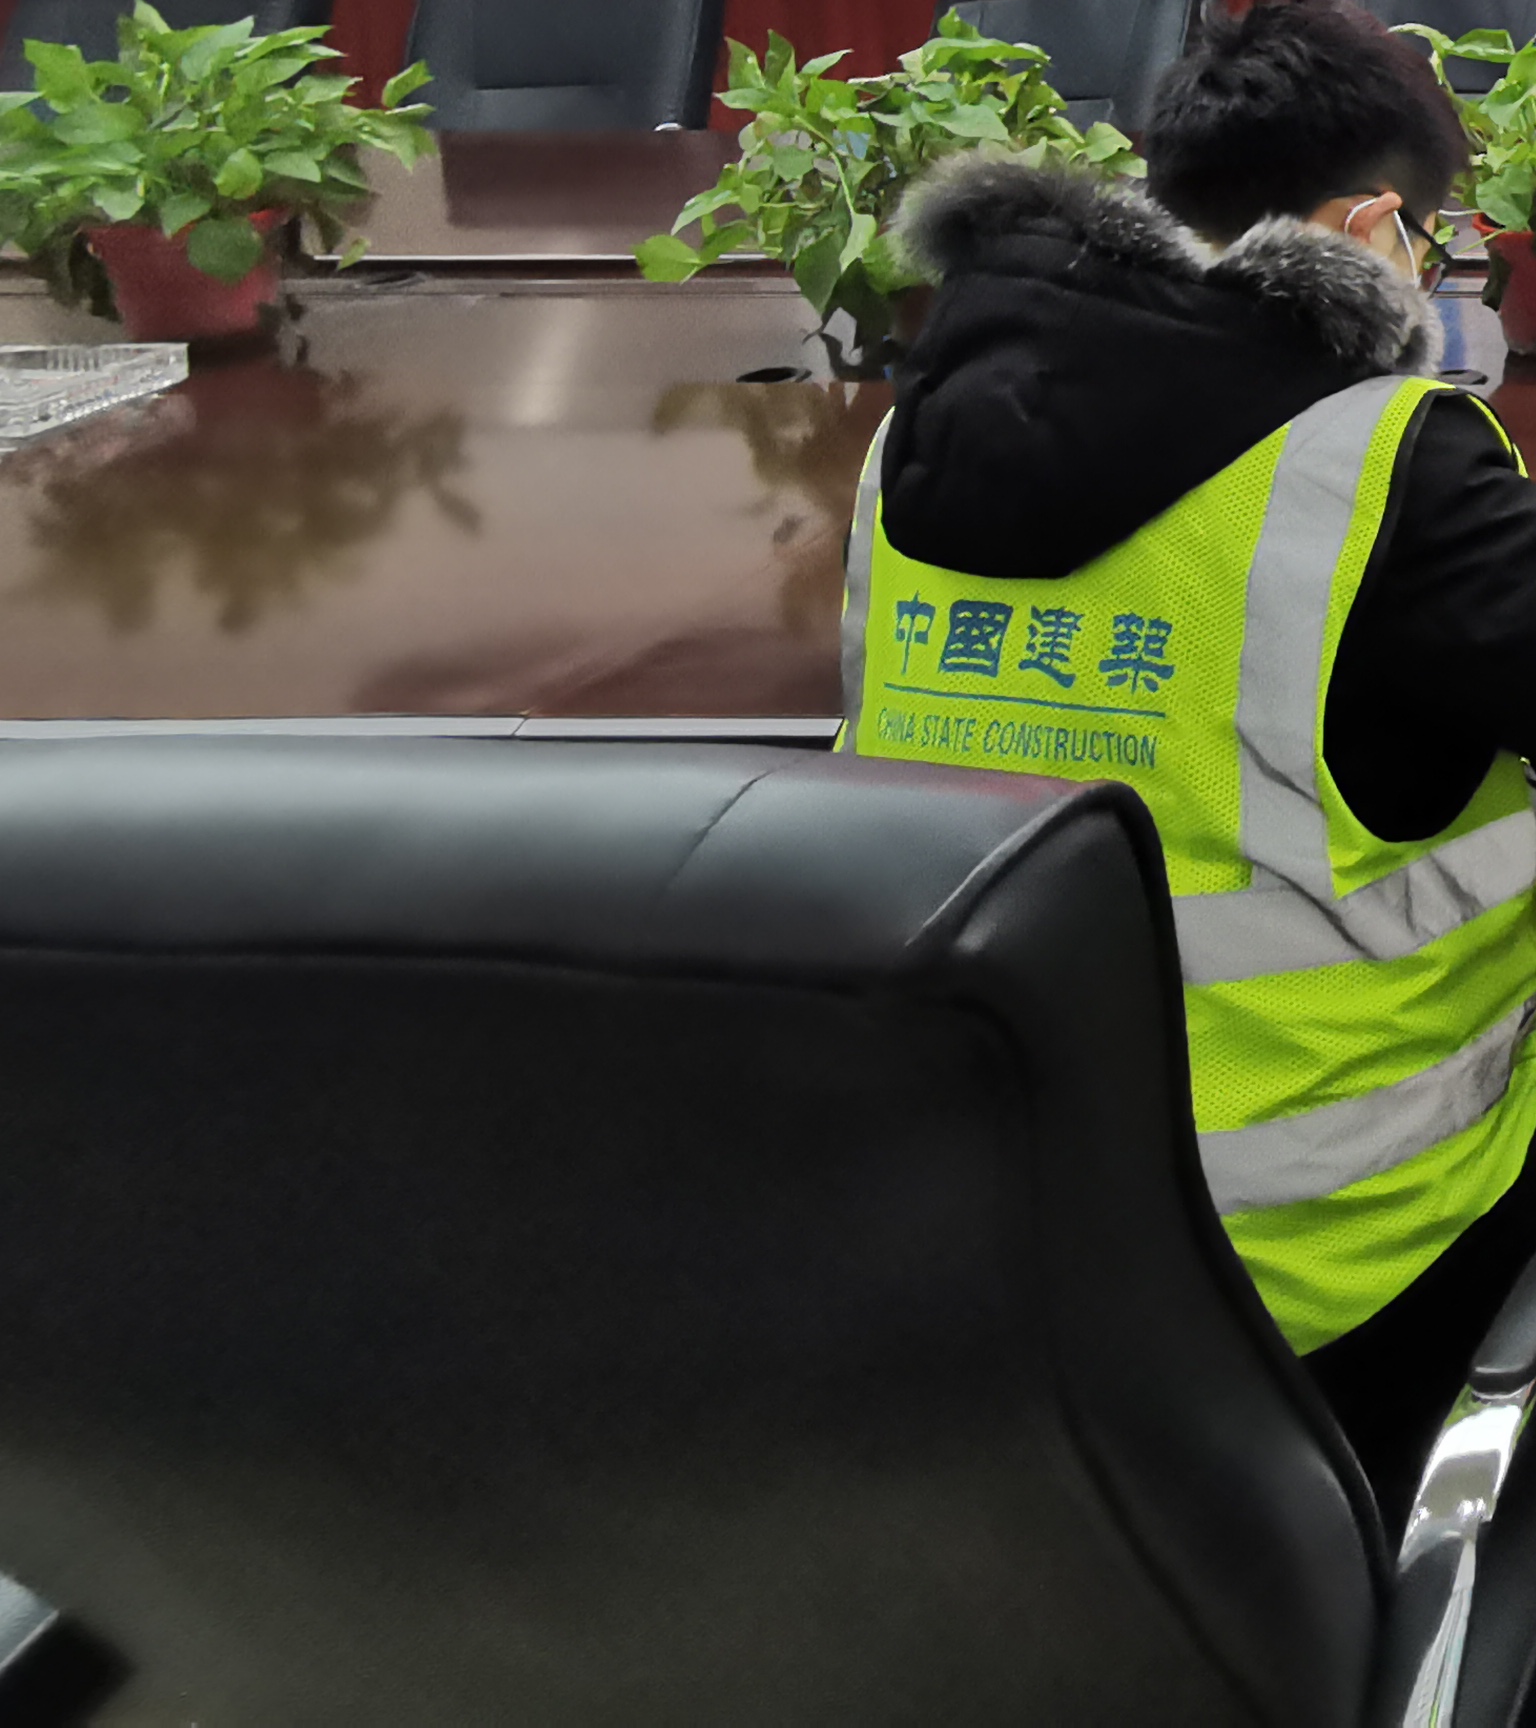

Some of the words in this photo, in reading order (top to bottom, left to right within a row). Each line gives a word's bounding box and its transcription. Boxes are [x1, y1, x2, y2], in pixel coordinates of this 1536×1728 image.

[895, 590, 1176, 695] 中國建築
[877, 707, 915, 742] CHINA
[921, 713, 976, 753] STATE
[982, 718, 1158, 769] CONSTRUCTION
